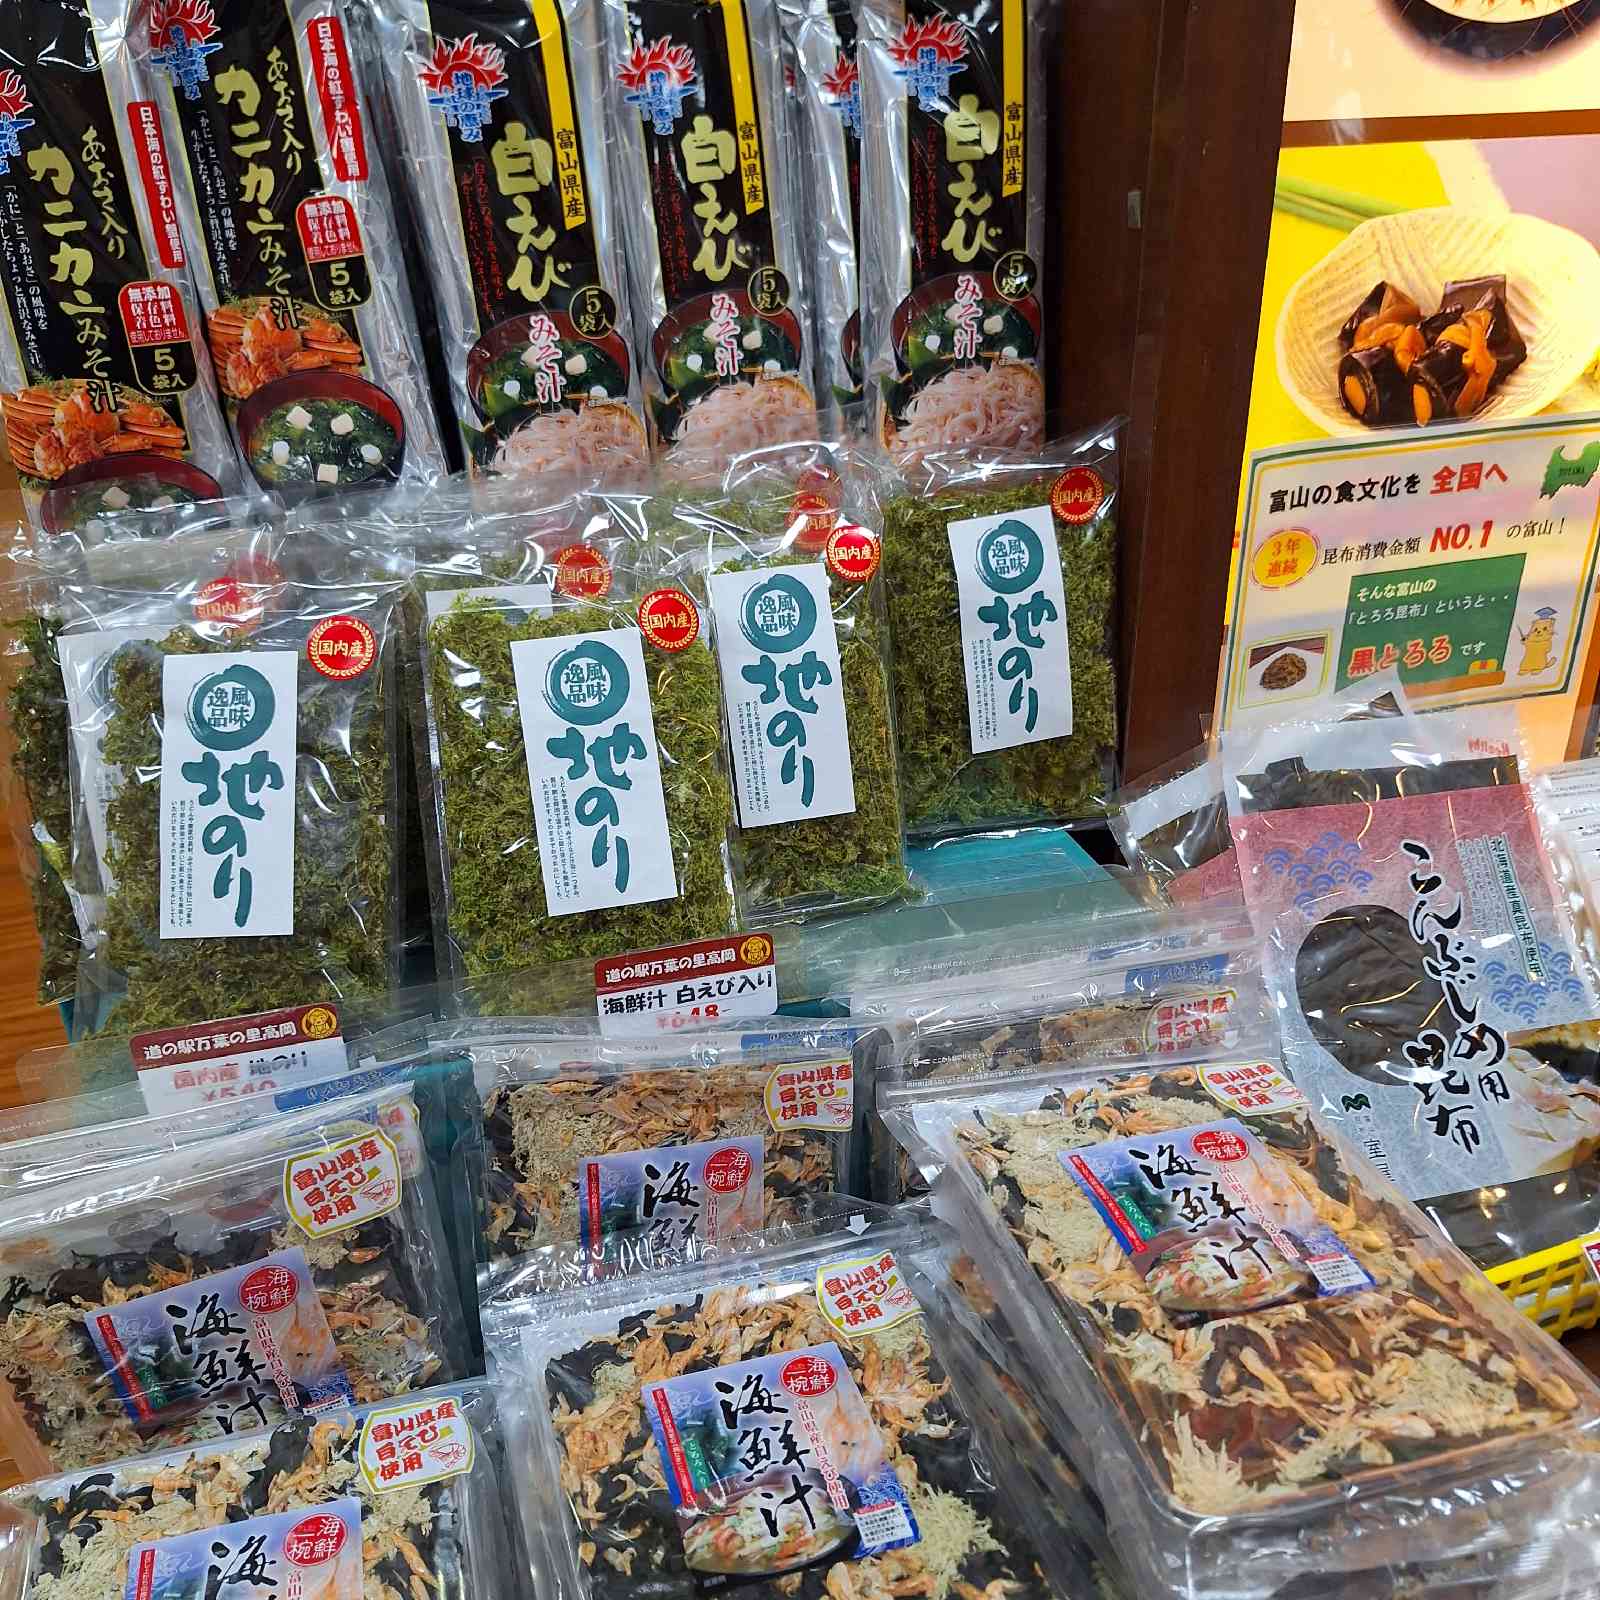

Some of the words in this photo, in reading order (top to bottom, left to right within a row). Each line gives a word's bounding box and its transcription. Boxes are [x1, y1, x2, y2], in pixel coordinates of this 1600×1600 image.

[737, 120, 764, 204] 富山県産
[1003, 101, 1023, 187] 富山県産
[81, 125, 128, 260] あおさ入り
[556, 128, 584, 219] 富山県産
[941, 93, 1003, 263] 白えび
[490, 122, 571, 302] 白えび
[680, 115, 751, 282] 白えび
[329, 262, 350, 286] 5
[762, 271, 776, 293] 5
[1009, 255, 1024, 277] 5
[328, 287, 362, 305] 袋入
[584, 290, 601, 314] 5
[711, 293, 743, 377] みそ汁
[953, 275, 982, 359] みそ汁
[154, 347, 176, 372] 5
[529, 314, 563, 403] みそ汁
[152, 373, 188, 390] 袋入
[1058, 488, 1095, 504] 国内産
[1269, 474, 1421, 515] 富山の食文化を
[1430, 461, 1509, 495] 全国へ
[834, 543, 873, 561] 国内産
[1321, 536, 1422, 566] 昆布消費金額
[1429, 519, 1494, 553] NO.1
[562, 568, 603, 584] 国内産
[1265, 558, 1299, 579] 連続
[1356, 578, 1438, 602] そんな富山の
[648, 611, 691, 629] 国内産
[319, 638, 365, 656] 国内産
[977, 590, 1058, 734] 地のり
[1348, 635, 1453, 678] 黒とろろ
[1460, 640, 1487, 656] です
[563, 662, 588, 705] 逸品
[584, 661, 607, 702] 風味
[207, 687, 229, 728] 逸品
[229, 686, 252, 728] 風味
[741, 650, 833, 808] 地のり
[547, 722, 648, 894] 地のり
[181, 750, 285, 928] 地のり
[605, 947, 737, 984] 道の駅万葉の里高岡
[602, 988, 668, 1015] 海鮮汁
[676, 970, 773, 1005] 白えび入り
[143, 1021, 298, 1061] 道の駅万葉の里高岡
[173, 1062, 242, 1090] 国内産
[776, 1063, 853, 1087] 富山県産
[778, 1082, 835, 1104] 白えび
[1207, 1063, 1277, 1085] 富山県産
[1223, 1076, 1273, 1095] 白えび
[781, 1101, 818, 1121] 使用
[1236, 1092, 1274, 1109] 使用
[292, 1139, 382, 1191] 富山県産
[303, 1164, 368, 1207] 白えび
[312, 1195, 357, 1226] 使用
[1128, 1144, 1273, 1281] 海鮮汁
[824, 1254, 898, 1297] 富山県産
[835, 1278, 889, 1310] 白えび
[844, 1306, 884, 1328] 使用
[166, 1293, 269, 1435] 海鮮汁
[807, 1356, 832, 1389] 海鮮
[371, 1401, 458, 1442] 富山県産
[375, 1422, 439, 1462] 白えび
[715, 1373, 817, 1538] 海鮮汁
[379, 1451, 424, 1482] 使用
[312, 1518, 340, 1558] 海鮮
